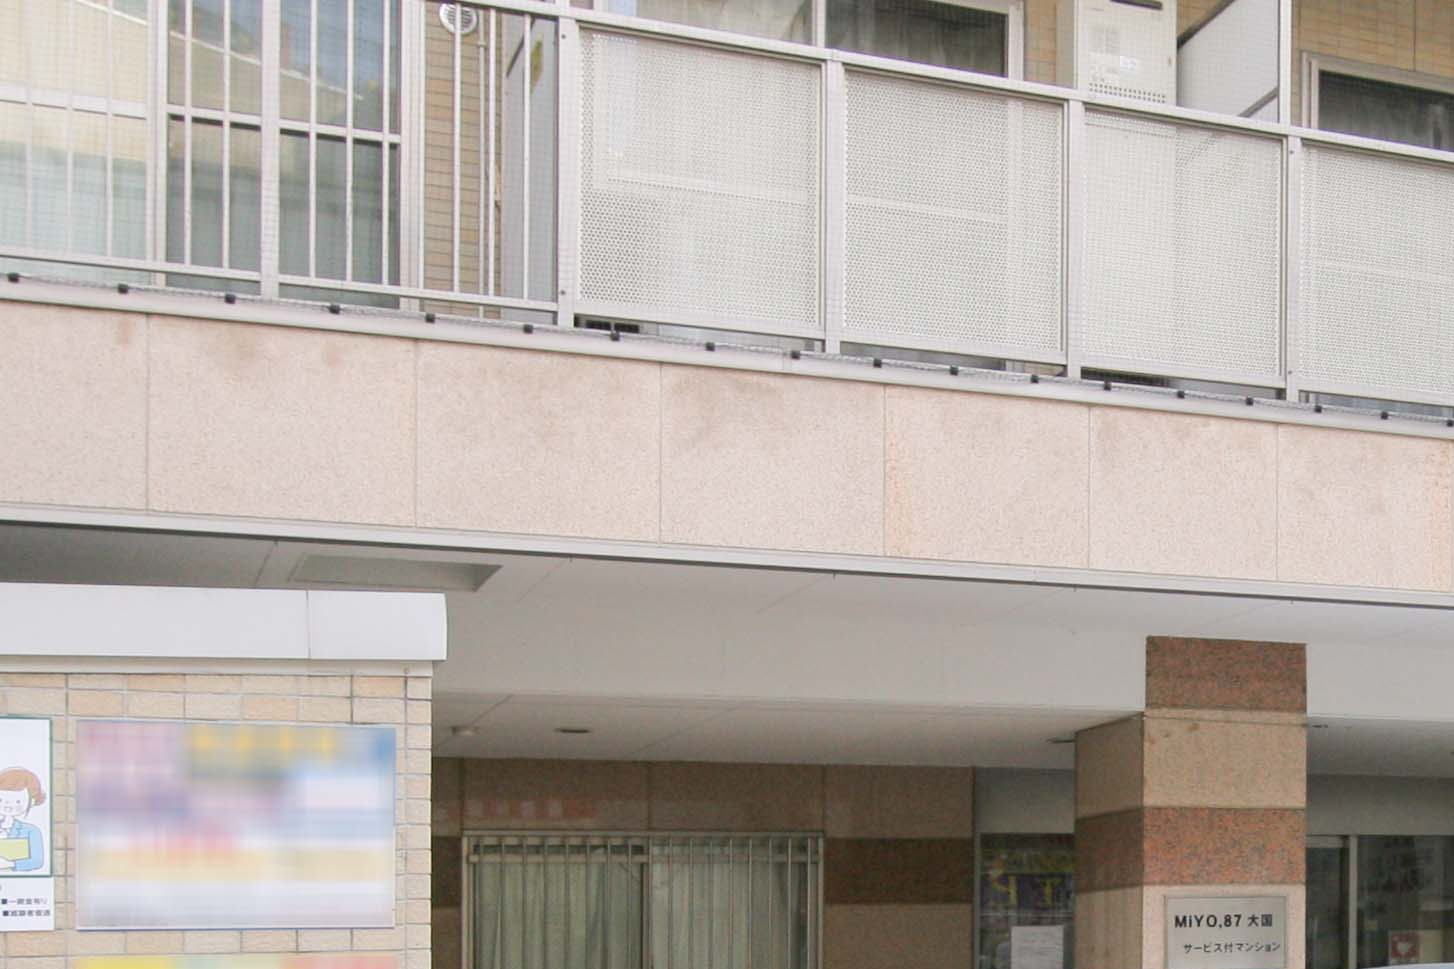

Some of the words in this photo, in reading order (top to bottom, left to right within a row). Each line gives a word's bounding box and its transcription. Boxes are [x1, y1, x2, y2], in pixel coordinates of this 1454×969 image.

[1247, 913, 1273, 928] 大国
[1183, 941, 1281, 954] サービス付マンション
